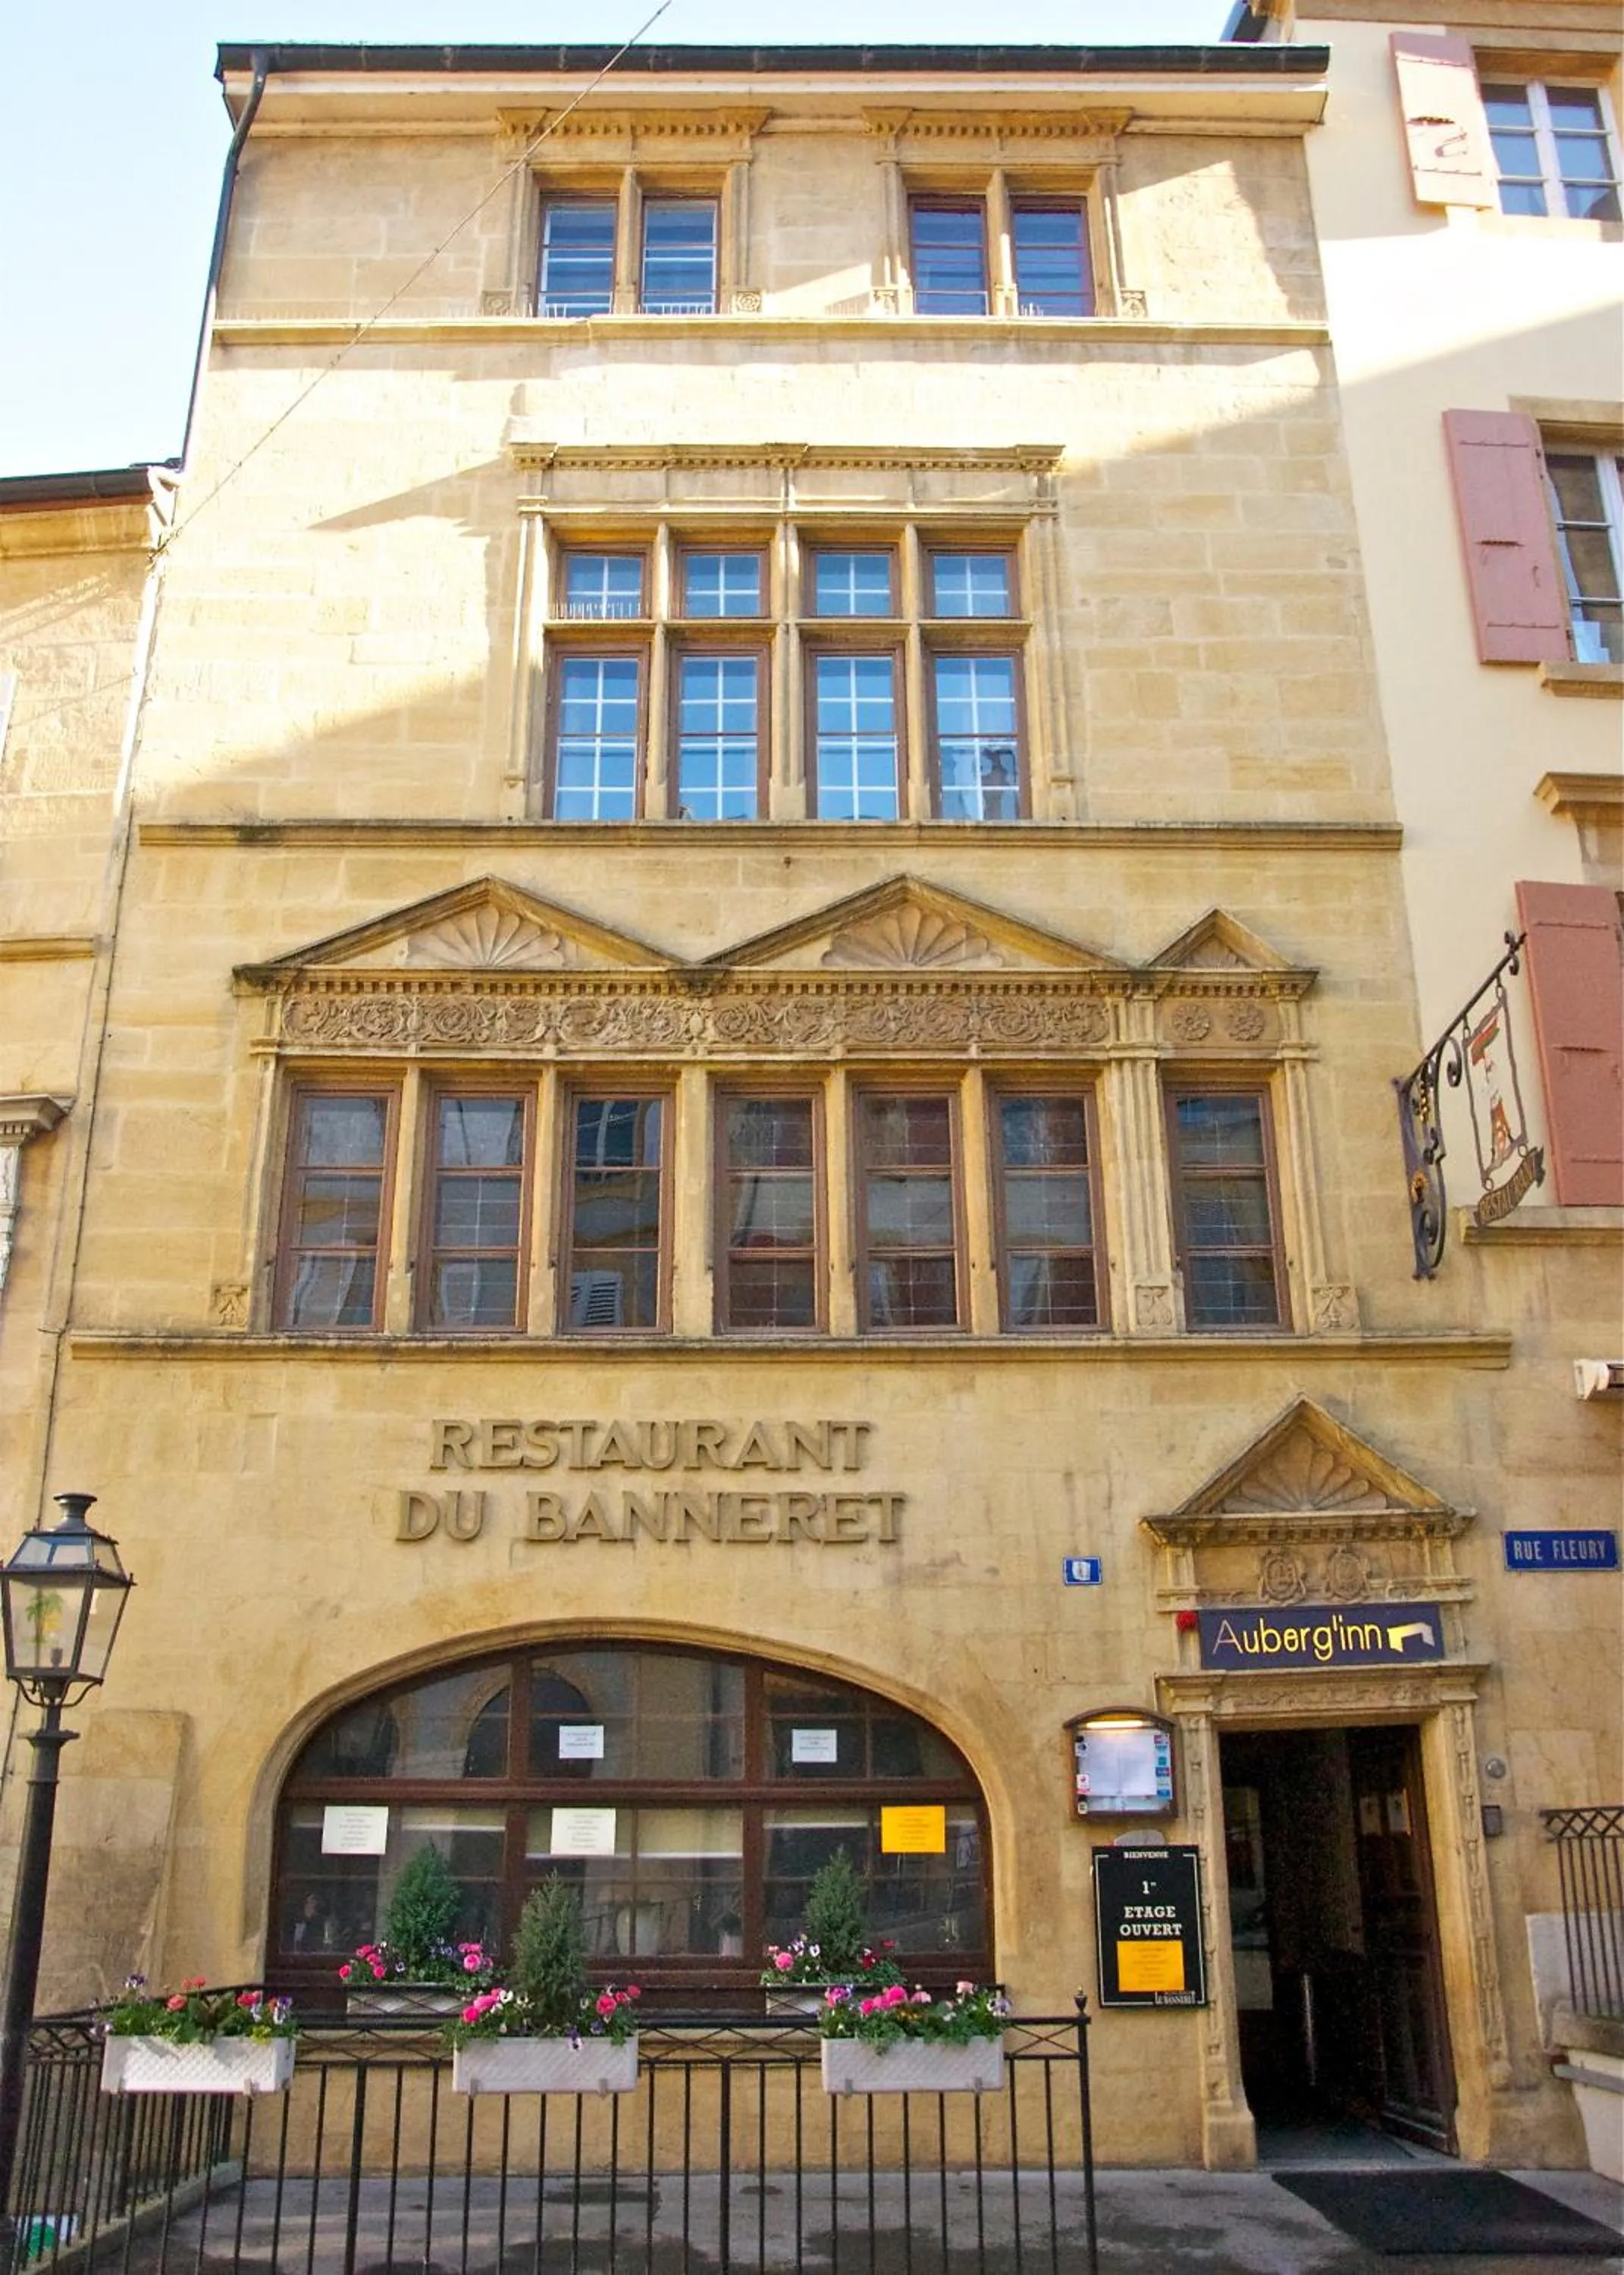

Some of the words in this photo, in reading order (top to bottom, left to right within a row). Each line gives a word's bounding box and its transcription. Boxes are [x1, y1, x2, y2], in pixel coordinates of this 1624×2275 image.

[429, 1419, 873, 1471] RESTAURANT
[396, 1490, 486, 1542] DU
[524, 1491, 908, 1542] BANNERET
[1513, 1539, 1544, 1561] RUE
[1551, 1539, 1606, 1561] FLEURY
[1212, 1614, 1382, 1661] Auberg'inn
[1119, 1923, 1183, 1936] OUVERT
[1124, 1906, 1177, 1919] ETAGE
